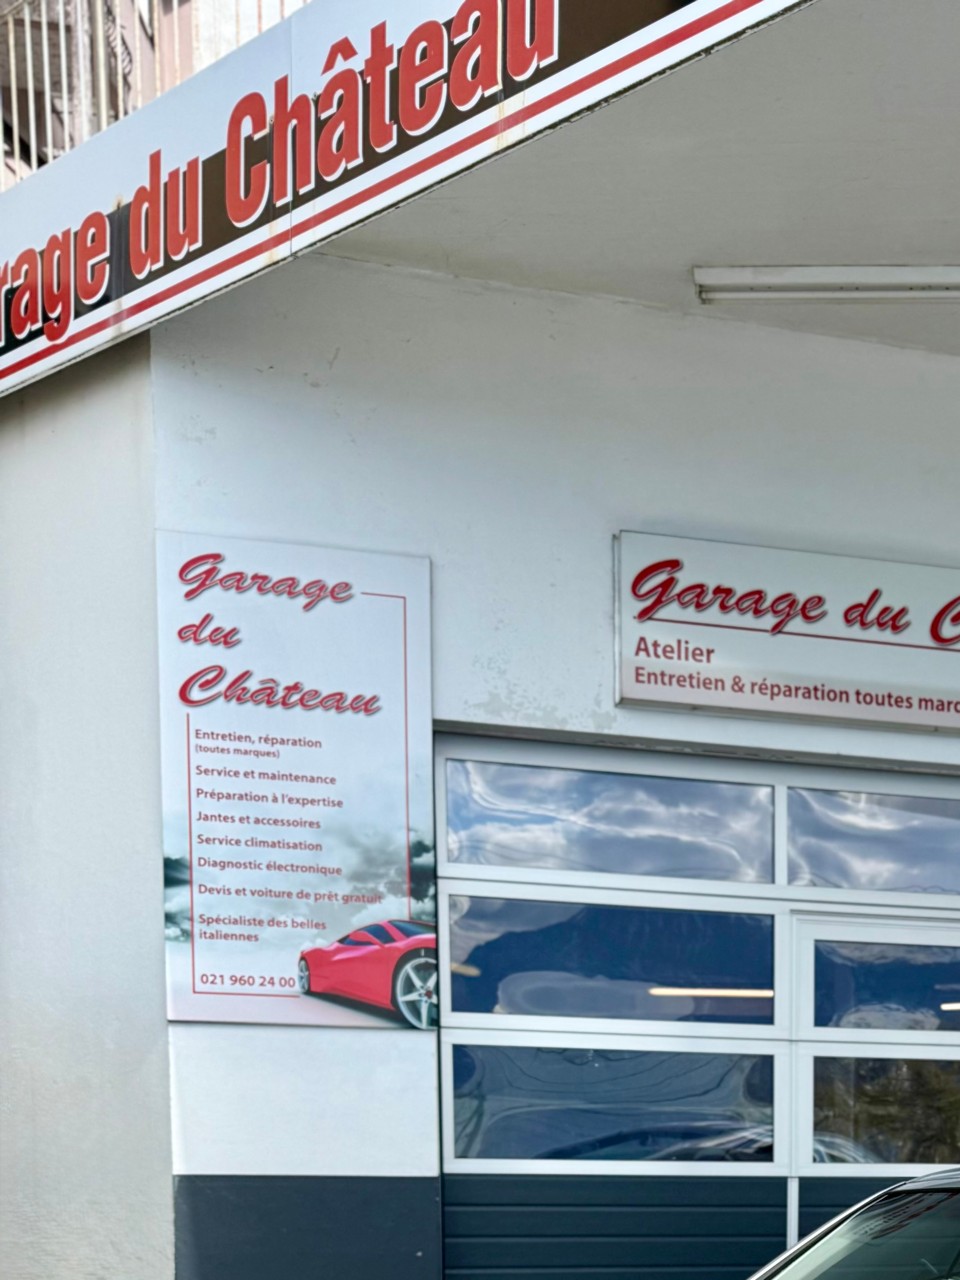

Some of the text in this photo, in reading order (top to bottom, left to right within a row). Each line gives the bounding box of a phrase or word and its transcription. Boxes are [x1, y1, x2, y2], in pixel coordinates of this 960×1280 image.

[129, 149, 202, 280] du
[225, 0, 559, 228] Château
[178, 553, 354, 611] Garage
[630, 559, 828, 635] Garage
[842, 587, 911, 634] du
[177, 613, 241, 648] du
[634, 636, 716, 664] Atelier
[178, 664, 382, 715] Château
[634, 666, 726, 692] Entretien
[731, 675, 746, 693] &
[750, 677, 850, 703] réparation
[855, 688, 913, 709] toutes
[195, 729, 322, 748] Entretien, réparation
[195, 744, 280, 759] (toutes marques)
[195, 765, 337, 785] Service et maintenance
[196, 788, 269, 803] Préparation
[271, 793, 279, 803] à
[196, 811, 321, 829] Jantes et accessoires
[197, 834, 323, 852] Service climatisation
[197, 857, 342, 876] Diagnostic électronique
[198, 884, 382, 905] Devis et voiture de prêt gratuit
[199, 914, 327, 930] Spécialiste des belles
[199, 929, 259, 942] italiennes
[200, 973, 296, 988] 021 960 24 00
